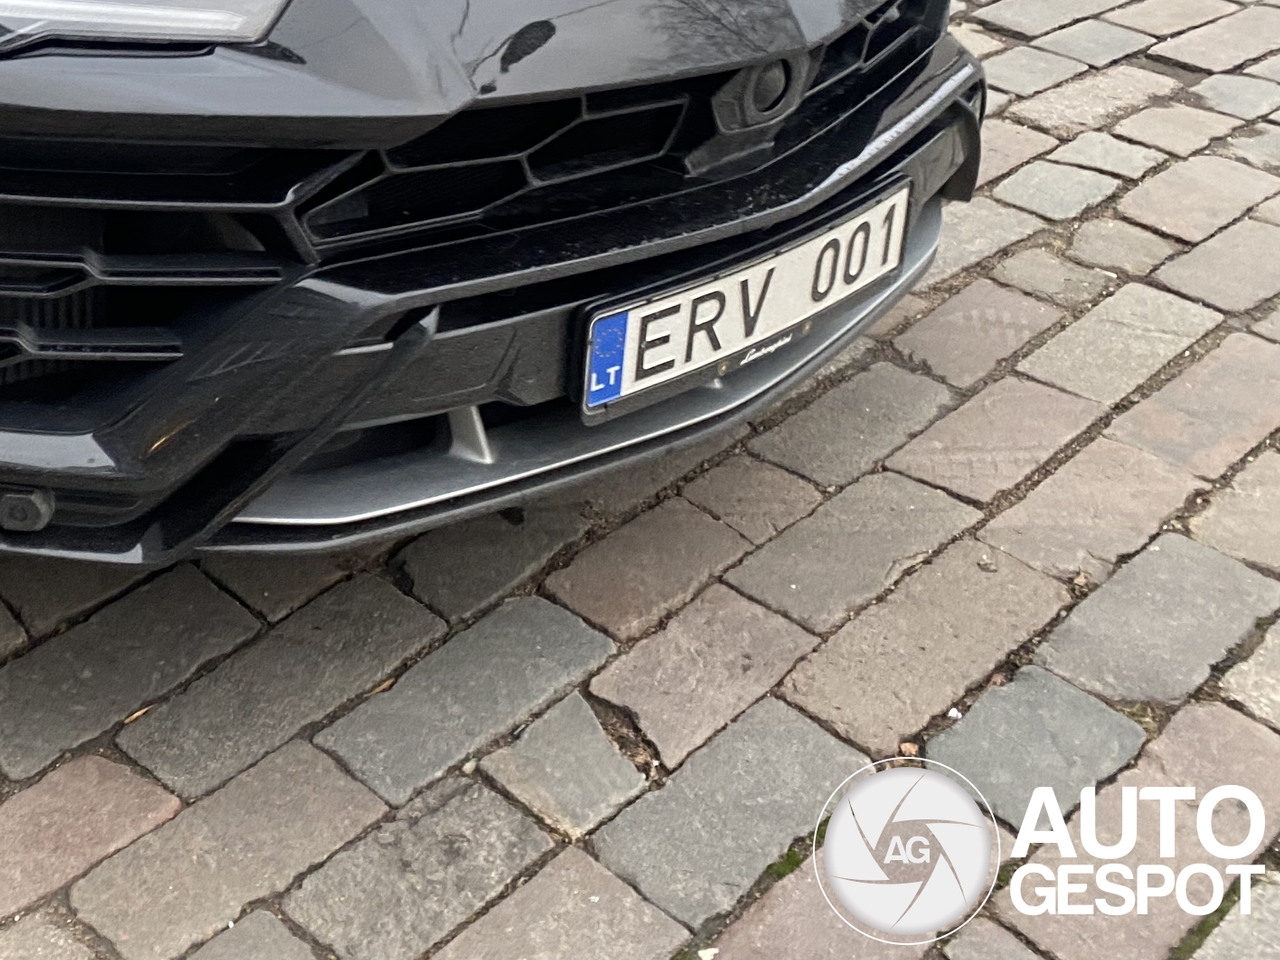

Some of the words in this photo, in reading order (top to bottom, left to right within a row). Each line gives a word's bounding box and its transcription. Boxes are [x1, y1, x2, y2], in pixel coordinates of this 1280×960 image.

[634, 266, 776, 381] ERV
[811, 202, 896, 303] 001
[590, 365, 620, 391] LT
